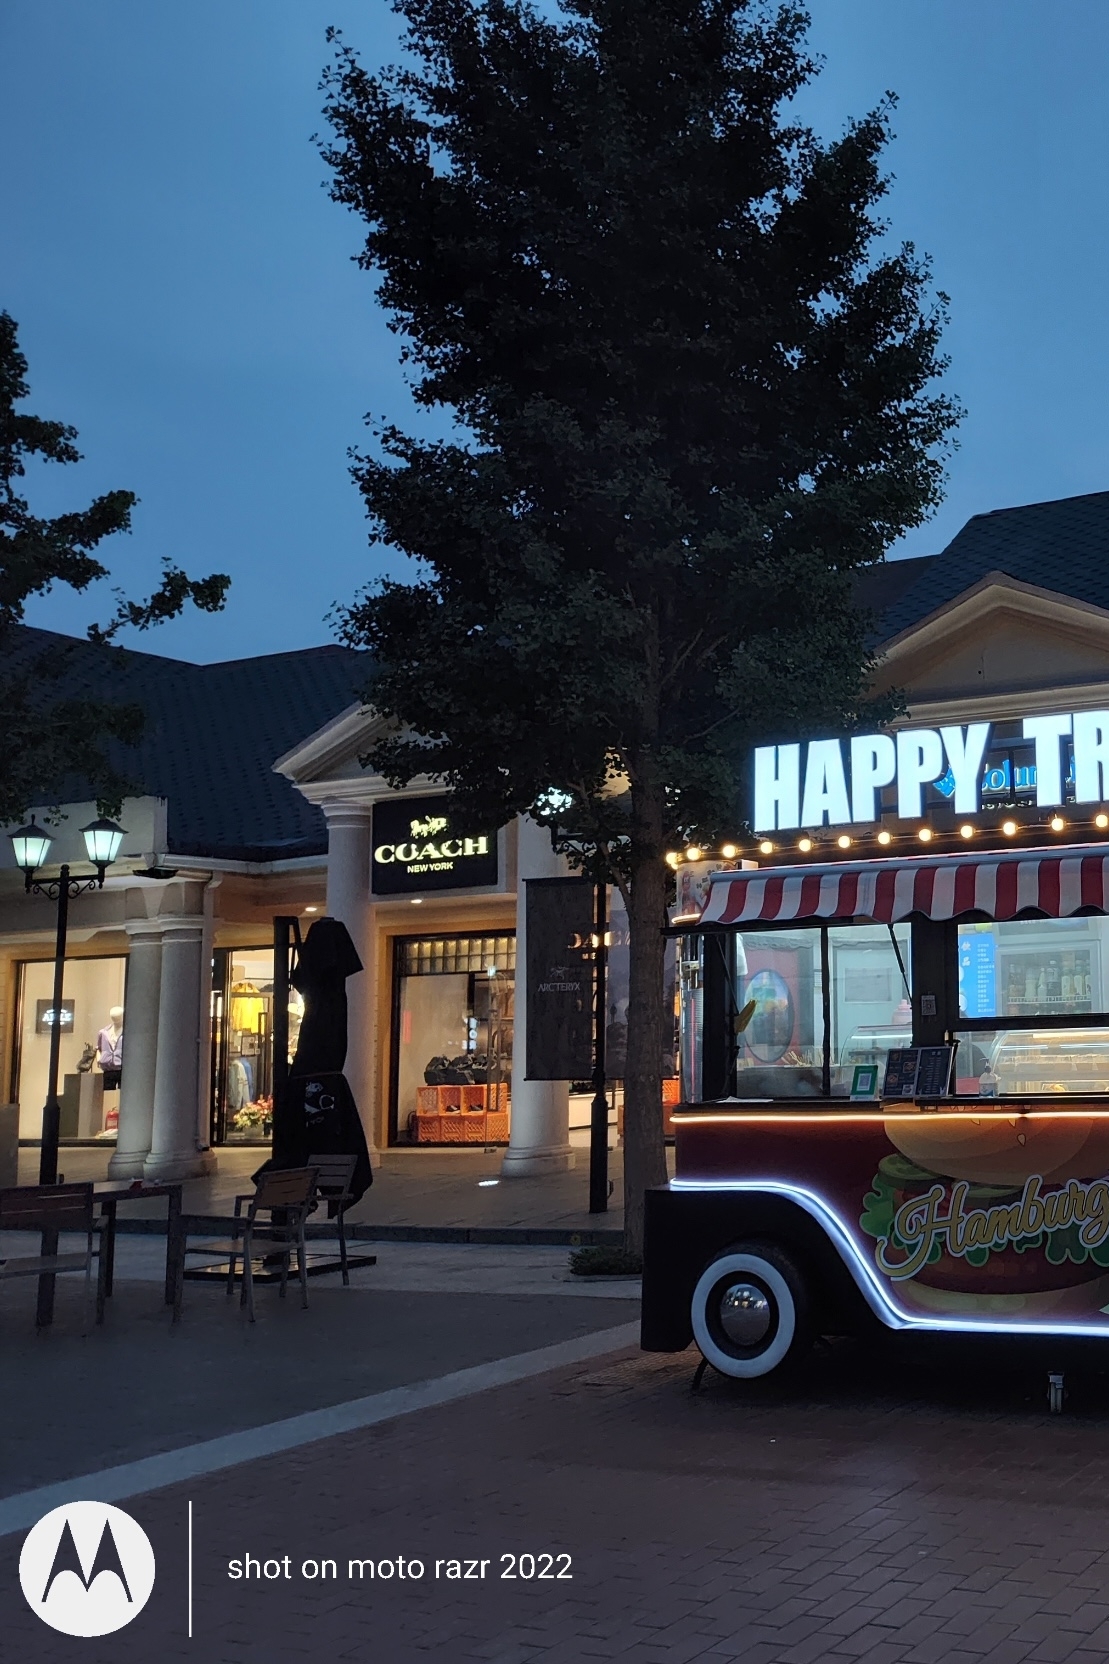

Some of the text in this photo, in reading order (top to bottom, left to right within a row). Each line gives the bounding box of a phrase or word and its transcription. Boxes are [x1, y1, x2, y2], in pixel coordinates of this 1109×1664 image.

[754, 723, 991, 832] HAPPY
[374, 836, 489, 863] COACH
[407, 861, 454, 873] NEW YORK
